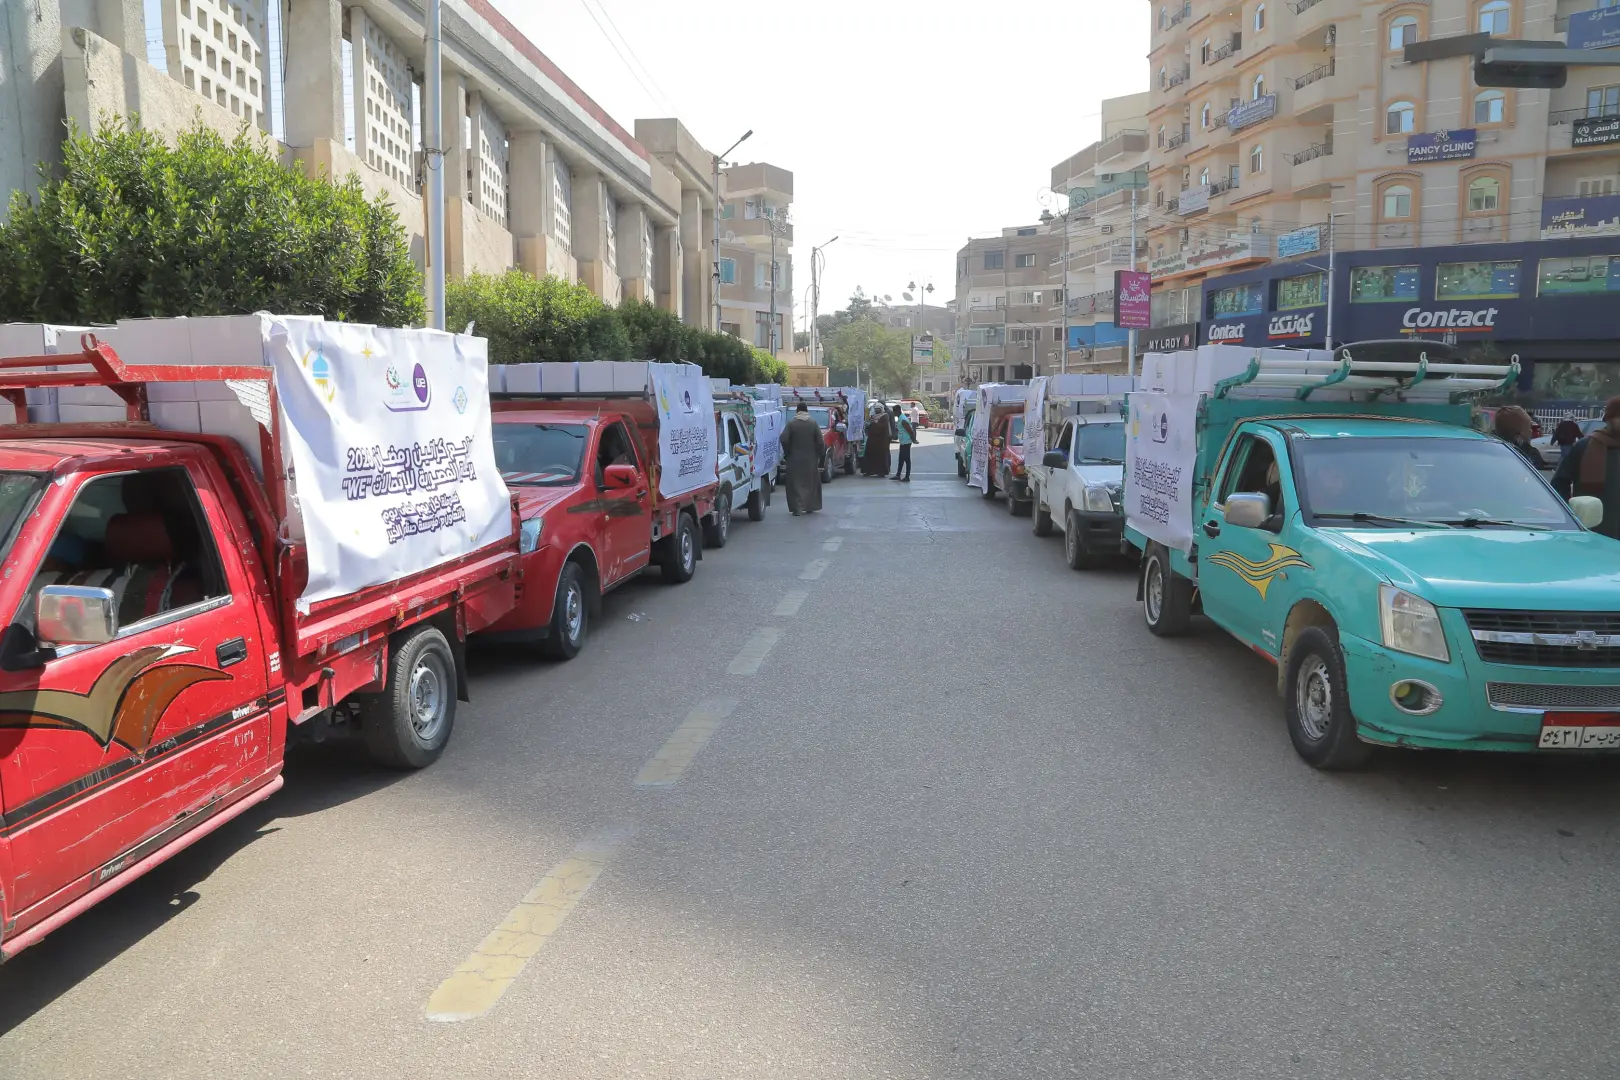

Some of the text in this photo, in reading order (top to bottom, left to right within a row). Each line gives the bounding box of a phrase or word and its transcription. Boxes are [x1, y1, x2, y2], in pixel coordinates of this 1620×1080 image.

[1408, 145, 1440, 156] FANCY
[1442, 141, 1474, 152] CLINIC
[1574, 135, 1609, 144] Makeup
[1268, 313, 1315, 336] كونتكت
[1403, 307, 1498, 328] Contact
[1208, 322, 1246, 341] Contact
